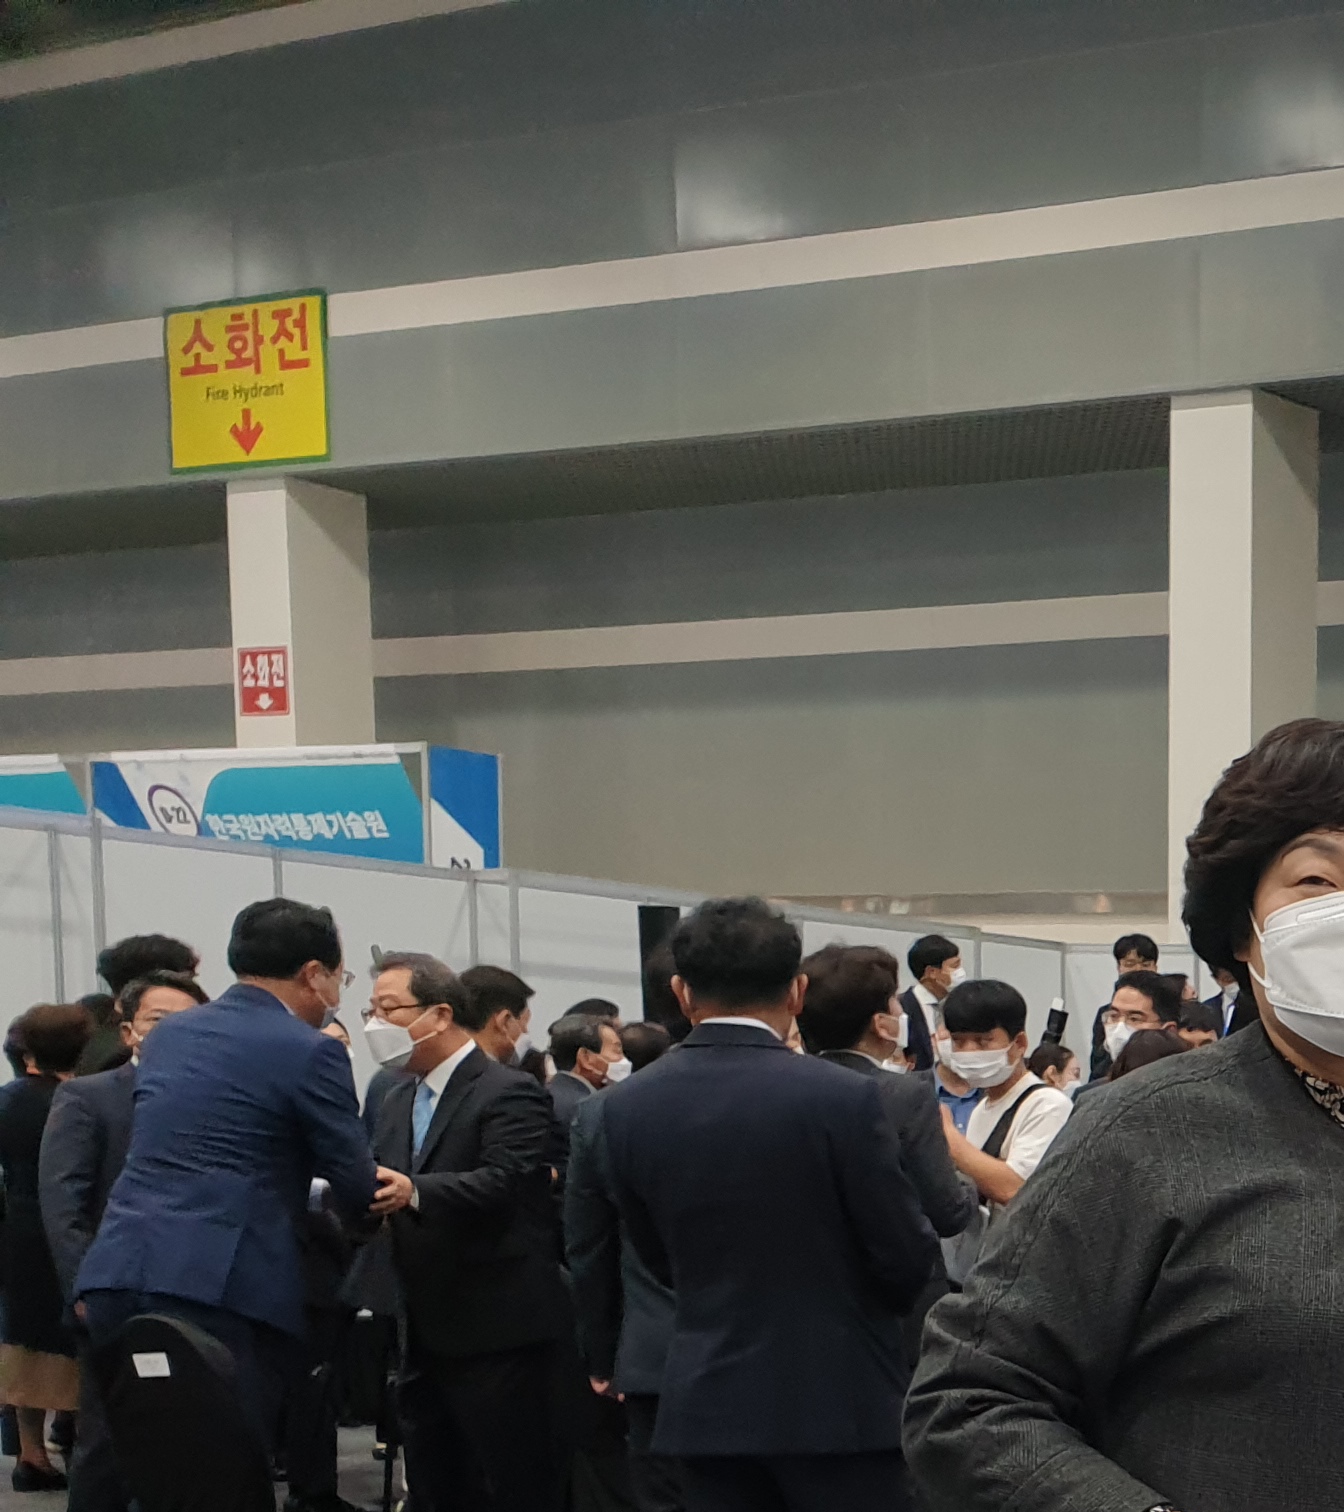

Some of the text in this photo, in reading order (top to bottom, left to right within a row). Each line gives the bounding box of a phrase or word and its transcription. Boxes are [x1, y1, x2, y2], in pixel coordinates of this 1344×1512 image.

[179, 302, 311, 377] 소화전
[205, 382, 285, 402] Fire Hydrant
[242, 653, 285, 688] 소화전
